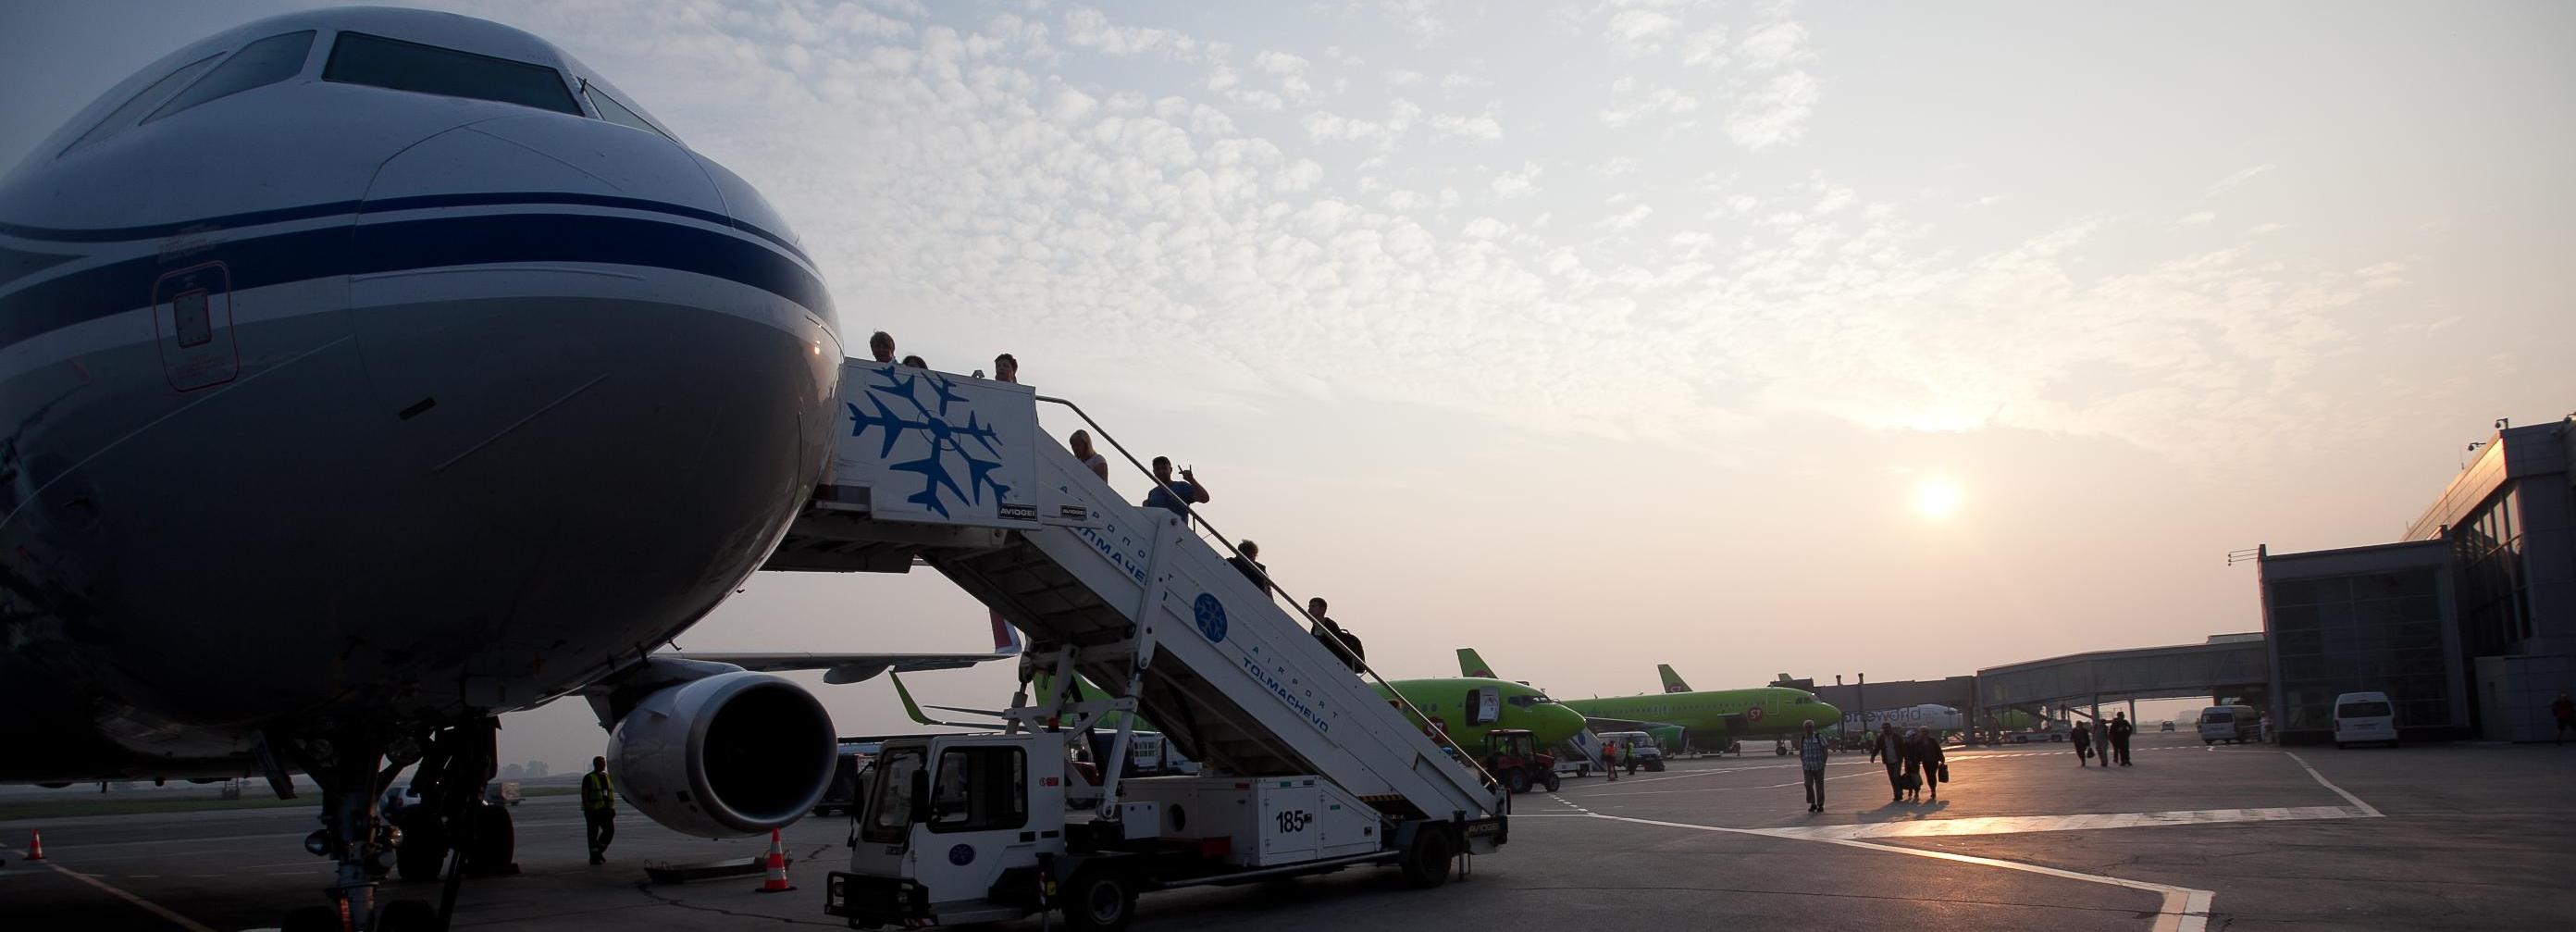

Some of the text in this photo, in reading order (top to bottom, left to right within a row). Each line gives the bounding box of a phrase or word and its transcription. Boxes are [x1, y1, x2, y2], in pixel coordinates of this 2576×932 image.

[1000, 508, 1035, 516] AVIOGEI
[1243, 657, 1330, 733] TOLMACHEVO
[1252, 646, 1339, 719] AIRPORT
[1275, 810, 1305, 833] 185
